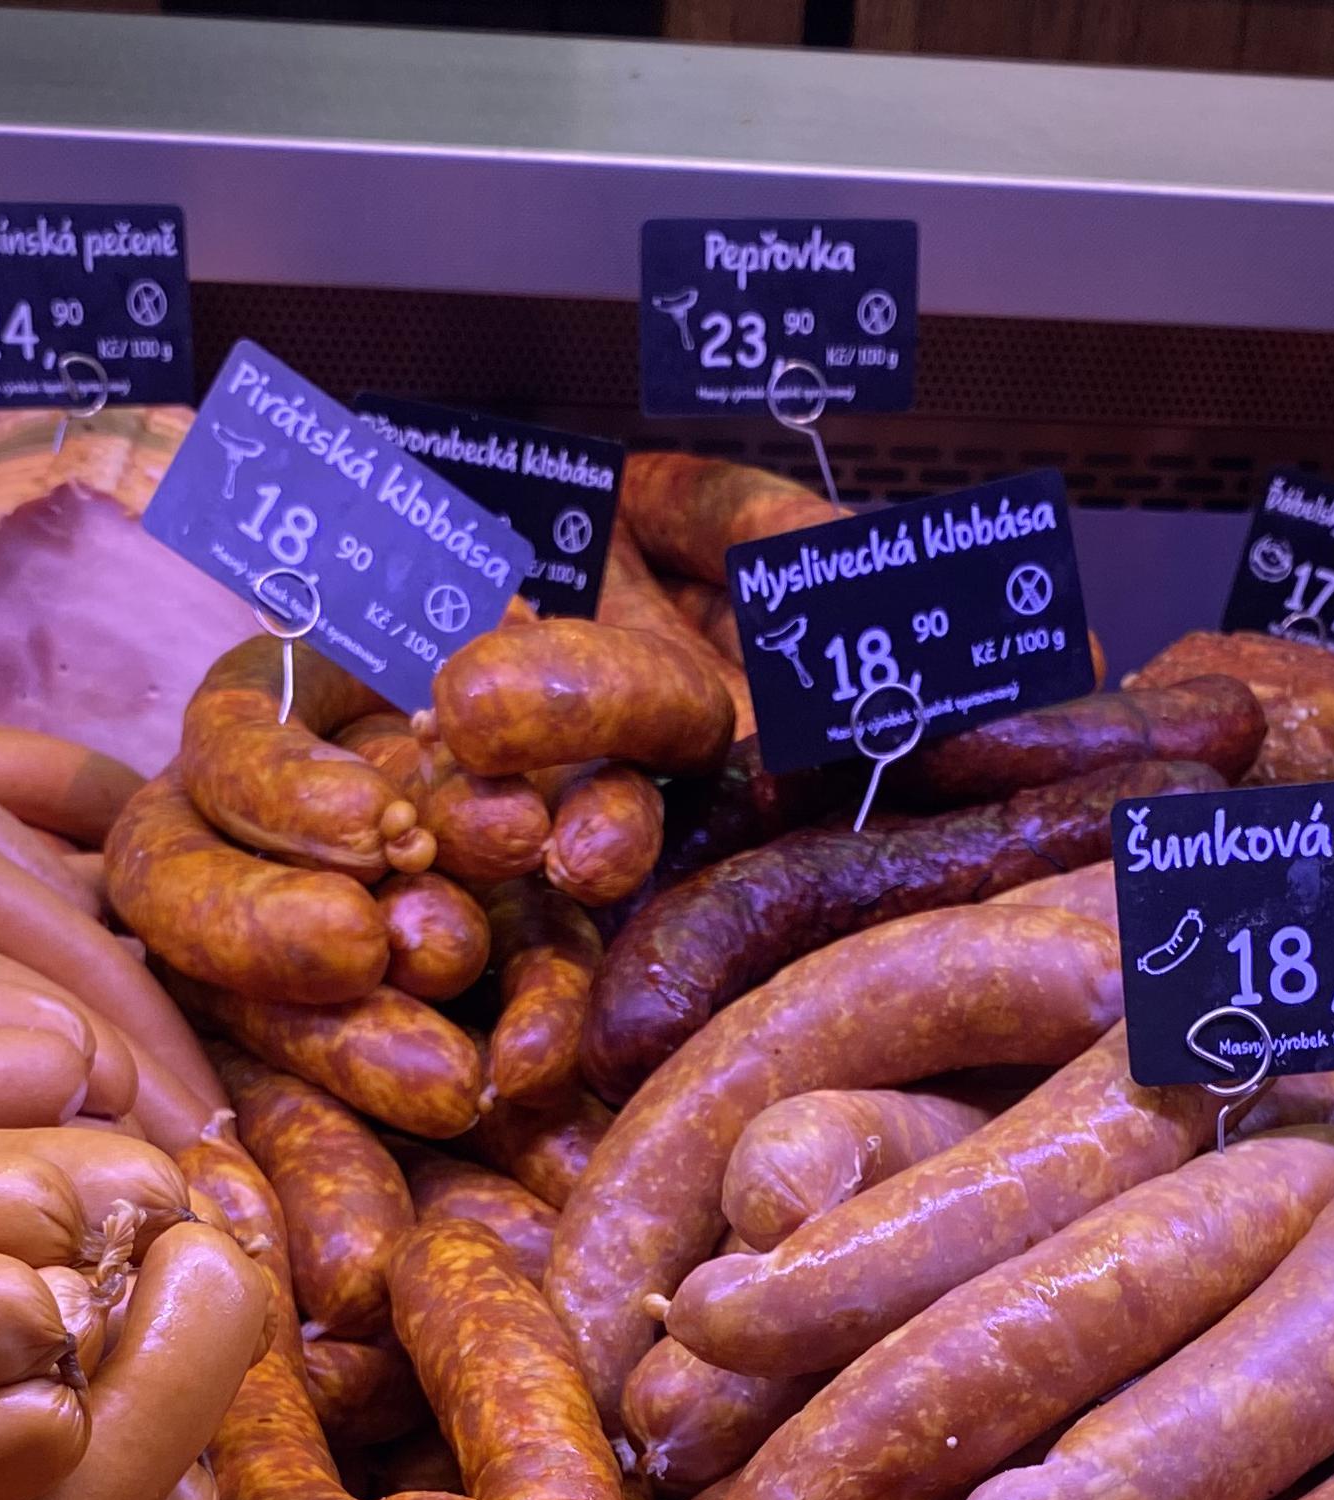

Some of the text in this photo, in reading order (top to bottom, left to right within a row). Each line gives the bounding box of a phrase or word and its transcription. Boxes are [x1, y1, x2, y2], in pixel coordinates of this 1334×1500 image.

[83, 218, 177, 273] pečeně
[704, 224, 855, 291] Pepřovka
[50, 297, 84, 327] 90
[783, 307, 815, 336] 90
[228, 360, 512, 588] Pirátská klobása
[521, 441, 614, 492] klobása
[335, 535, 374, 572] 90
[737, 497, 1057, 612] Myslivecká klobása
[365, 602, 395, 629] Kč
[405, 629, 438, 662] 100
[912, 608, 949, 644] 90
[971, 638, 996, 668] Kč
[1016, 627, 1049, 656] 100
[1051, 628, 1065, 651] g
[1126, 801, 1334, 873] Šunková
[1270, 1029, 1329, 1057] výrobek
